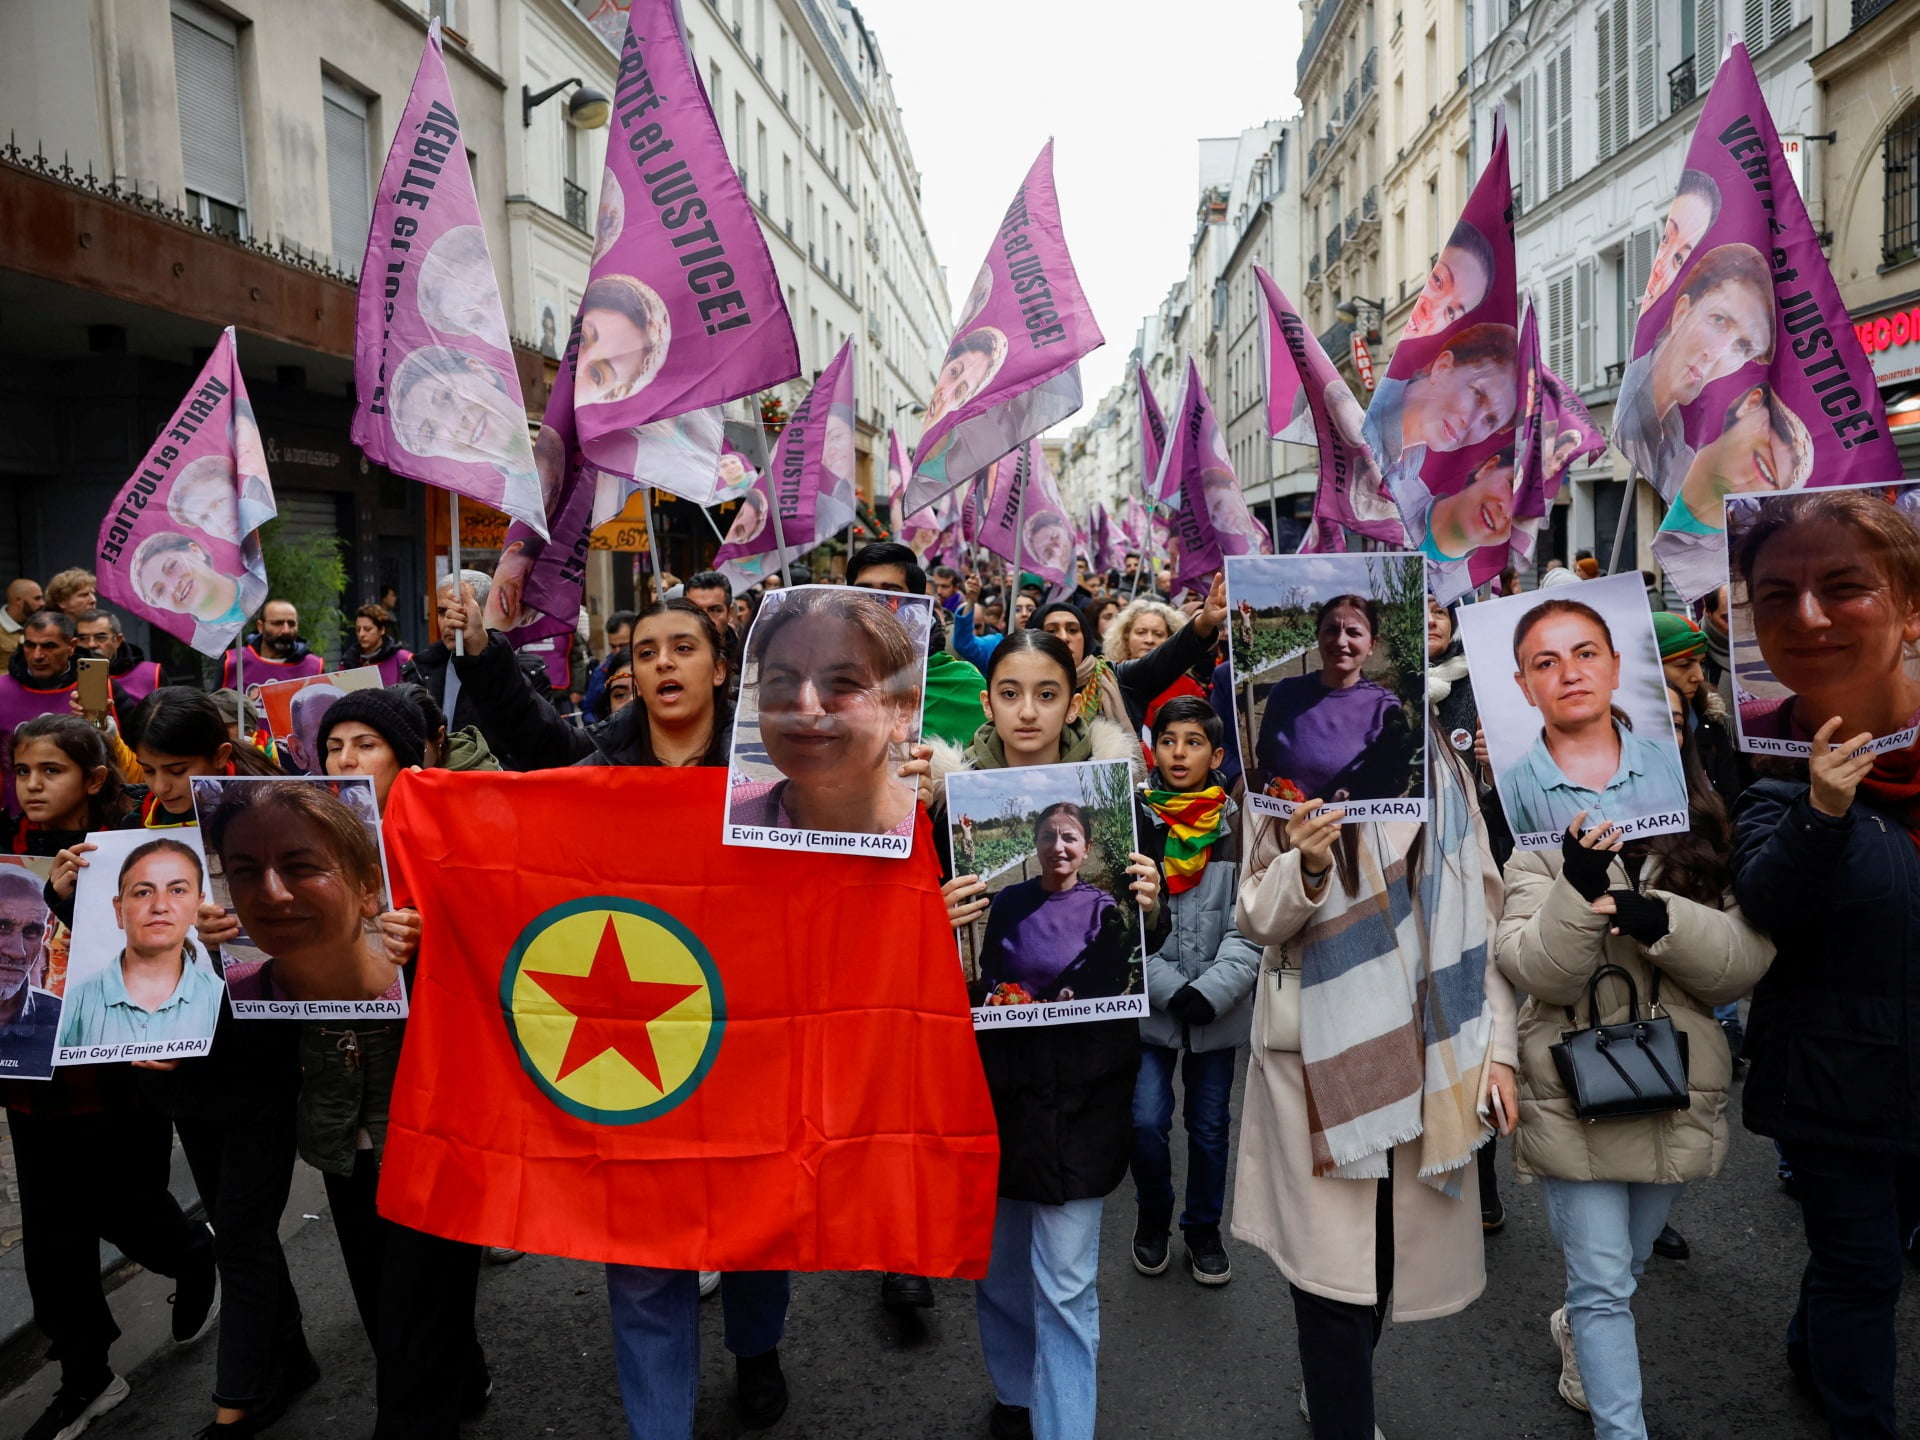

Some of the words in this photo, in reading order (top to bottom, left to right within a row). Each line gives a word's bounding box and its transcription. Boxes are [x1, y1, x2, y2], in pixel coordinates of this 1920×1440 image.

[615, 24, 668, 130] ÉRITÉ
[629, 122, 675, 168] et
[643, 159, 752, 337] JUSTICE!
[1004, 234, 1034, 260] et
[1771, 247, 1799, 285] et
[1008, 255, 1066, 350] JUSTICE!
[1354, 335, 1375, 390] TABAC
[1779, 290, 1880, 450] JUSTICE!
[787, 427, 804, 444] et
[779, 449, 805, 520] JUSTICE!
[1748, 739, 1780, 750] Evin
[1785, 742, 1812, 756] Goy
[1876, 730, 1914, 750] KARA)
[1253, 797, 1281, 812] Evin
[1316, 805, 1367, 817] (Eine
[1371, 802, 1421, 818] KARA)
[731, 827, 764, 841] Evin
[768, 830, 803, 846] Goyî
[806, 832, 856, 848] (Emine
[860, 835, 908, 854] KARA)
[1520, 835, 1548, 846] Evin
[1636, 812, 1686, 831] KARA)
[235, 1002, 266, 1014] Evin
[269, 1002, 300, 1016] Goyî
[303, 1002, 351, 1016] (Emine
[354, 1002, 401, 1015] KARA)
[971, 1012, 1002, 1024] Evin
[1006, 1008, 1040, 1023] Goyî
[1042, 1004, 1092, 1022] (Emine
[1095, 998, 1142, 1014] KARA)
[59, 1048, 87, 1060] Evin
[90, 1045, 119, 1059] Goyî
[120, 1043, 164, 1058] (Emine
[166, 1039, 208, 1054] KARA)
